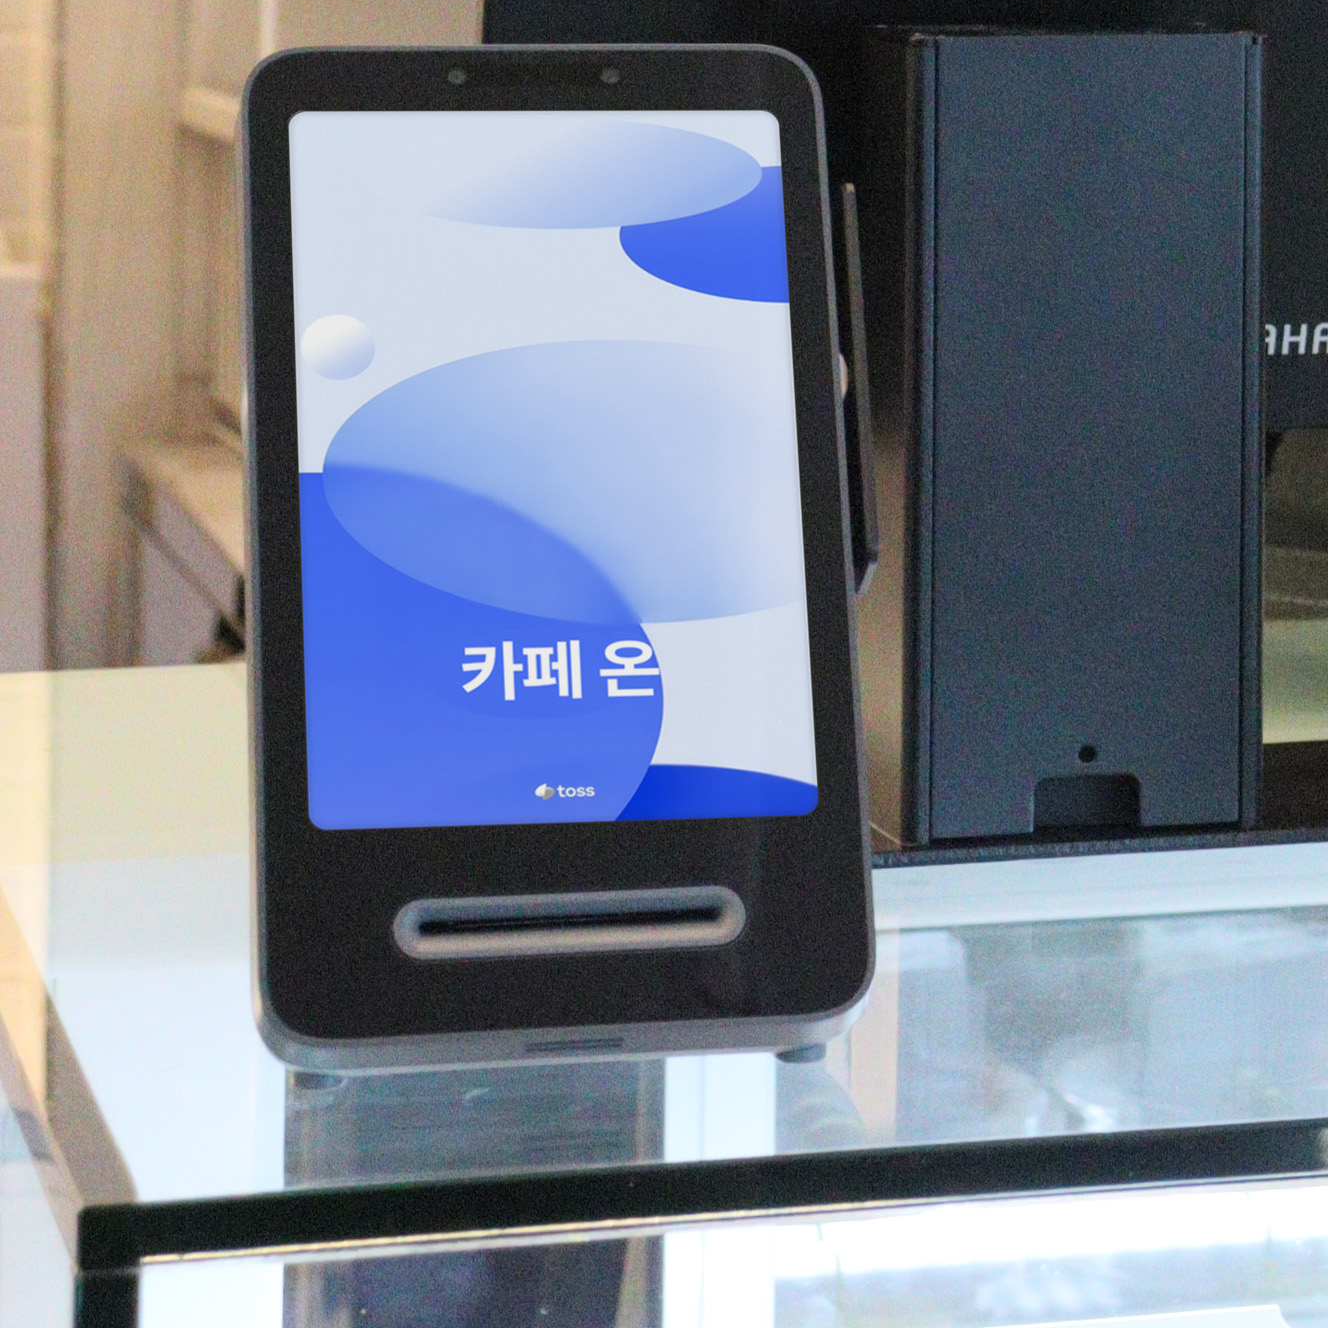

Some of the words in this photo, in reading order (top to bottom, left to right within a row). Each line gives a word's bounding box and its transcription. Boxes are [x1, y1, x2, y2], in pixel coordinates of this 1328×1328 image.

[462, 640, 582, 701] 카페
[599, 640, 660, 697] 온
[556, 784, 596, 798] toss
